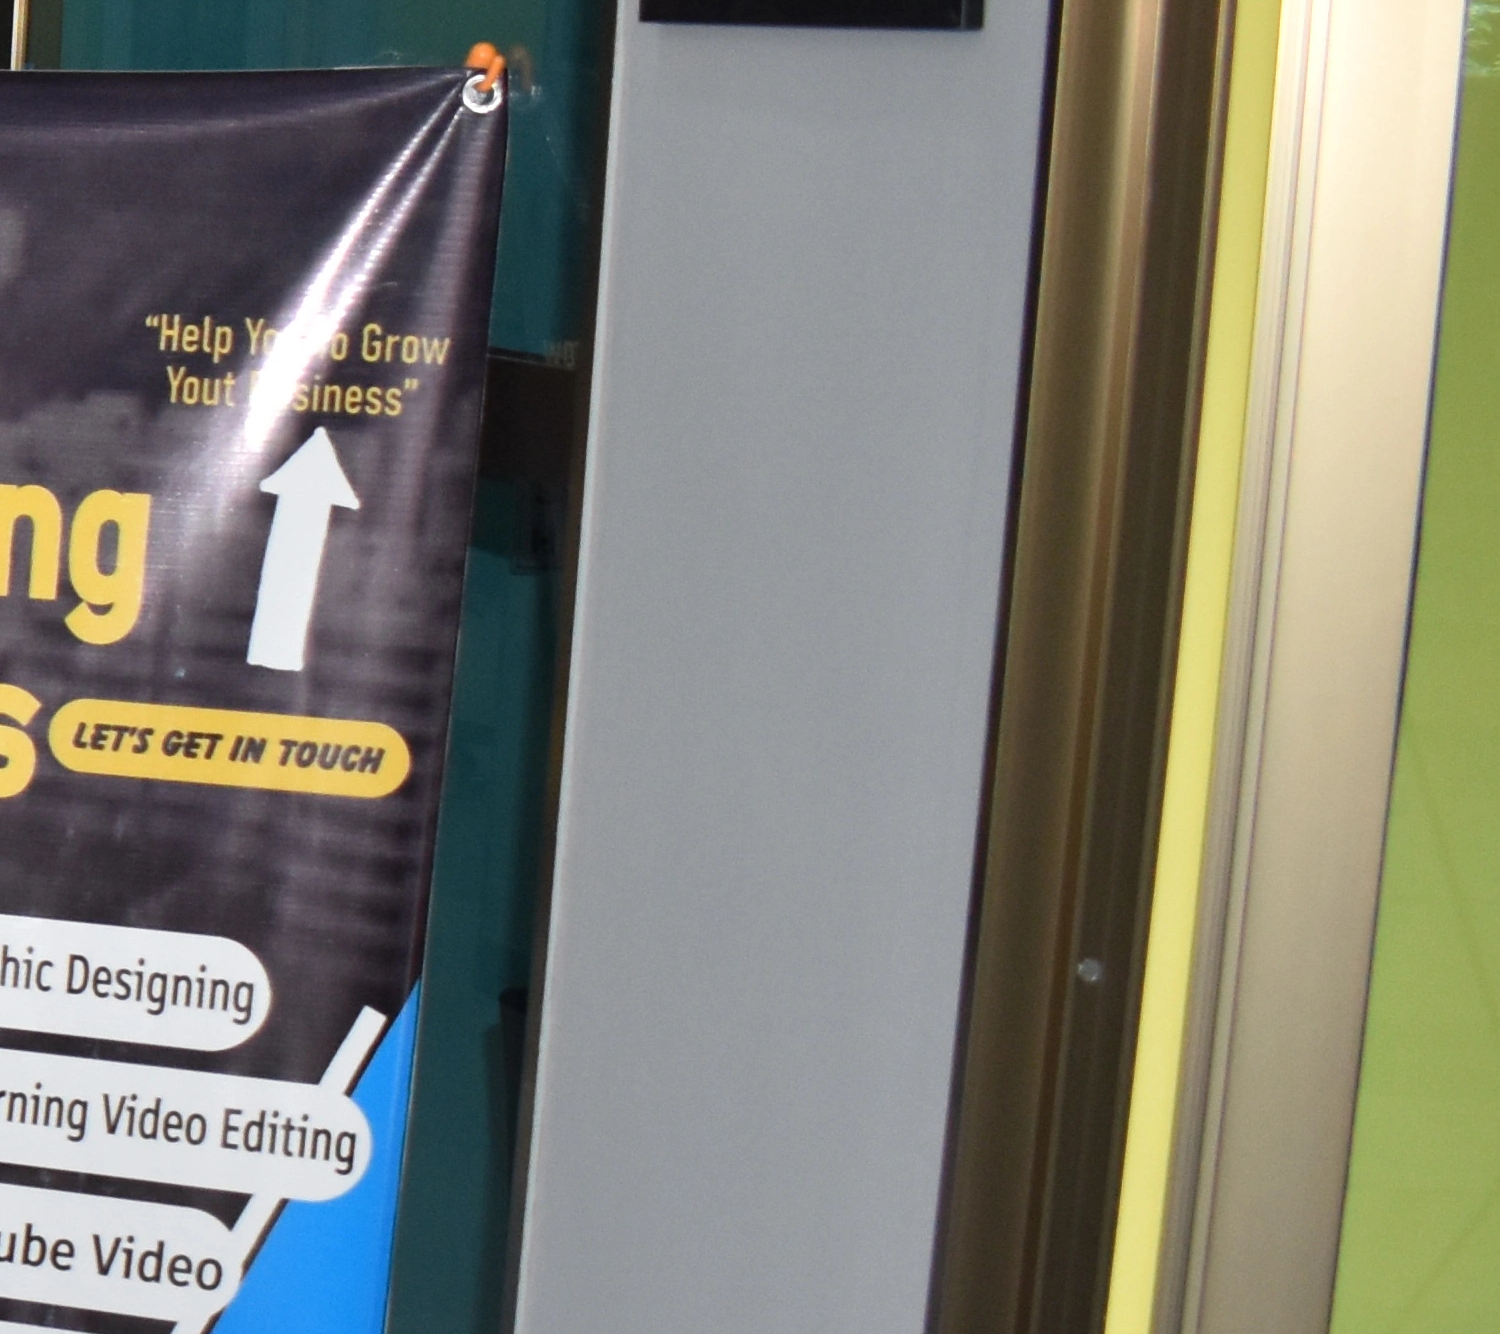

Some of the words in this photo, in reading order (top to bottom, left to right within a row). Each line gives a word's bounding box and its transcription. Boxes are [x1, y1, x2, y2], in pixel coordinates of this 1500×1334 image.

[73, 722, 154, 754] LET'S
[162, 730, 223, 760] GET
[229, 736, 267, 763] IN
[280, 739, 385, 774] TOUCH
[67, 954, 254, 1025] Designing
[103, 1094, 206, 1145] Video
[221, 1109, 356, 1175] Editing
[93, 1234, 222, 1290] Video
